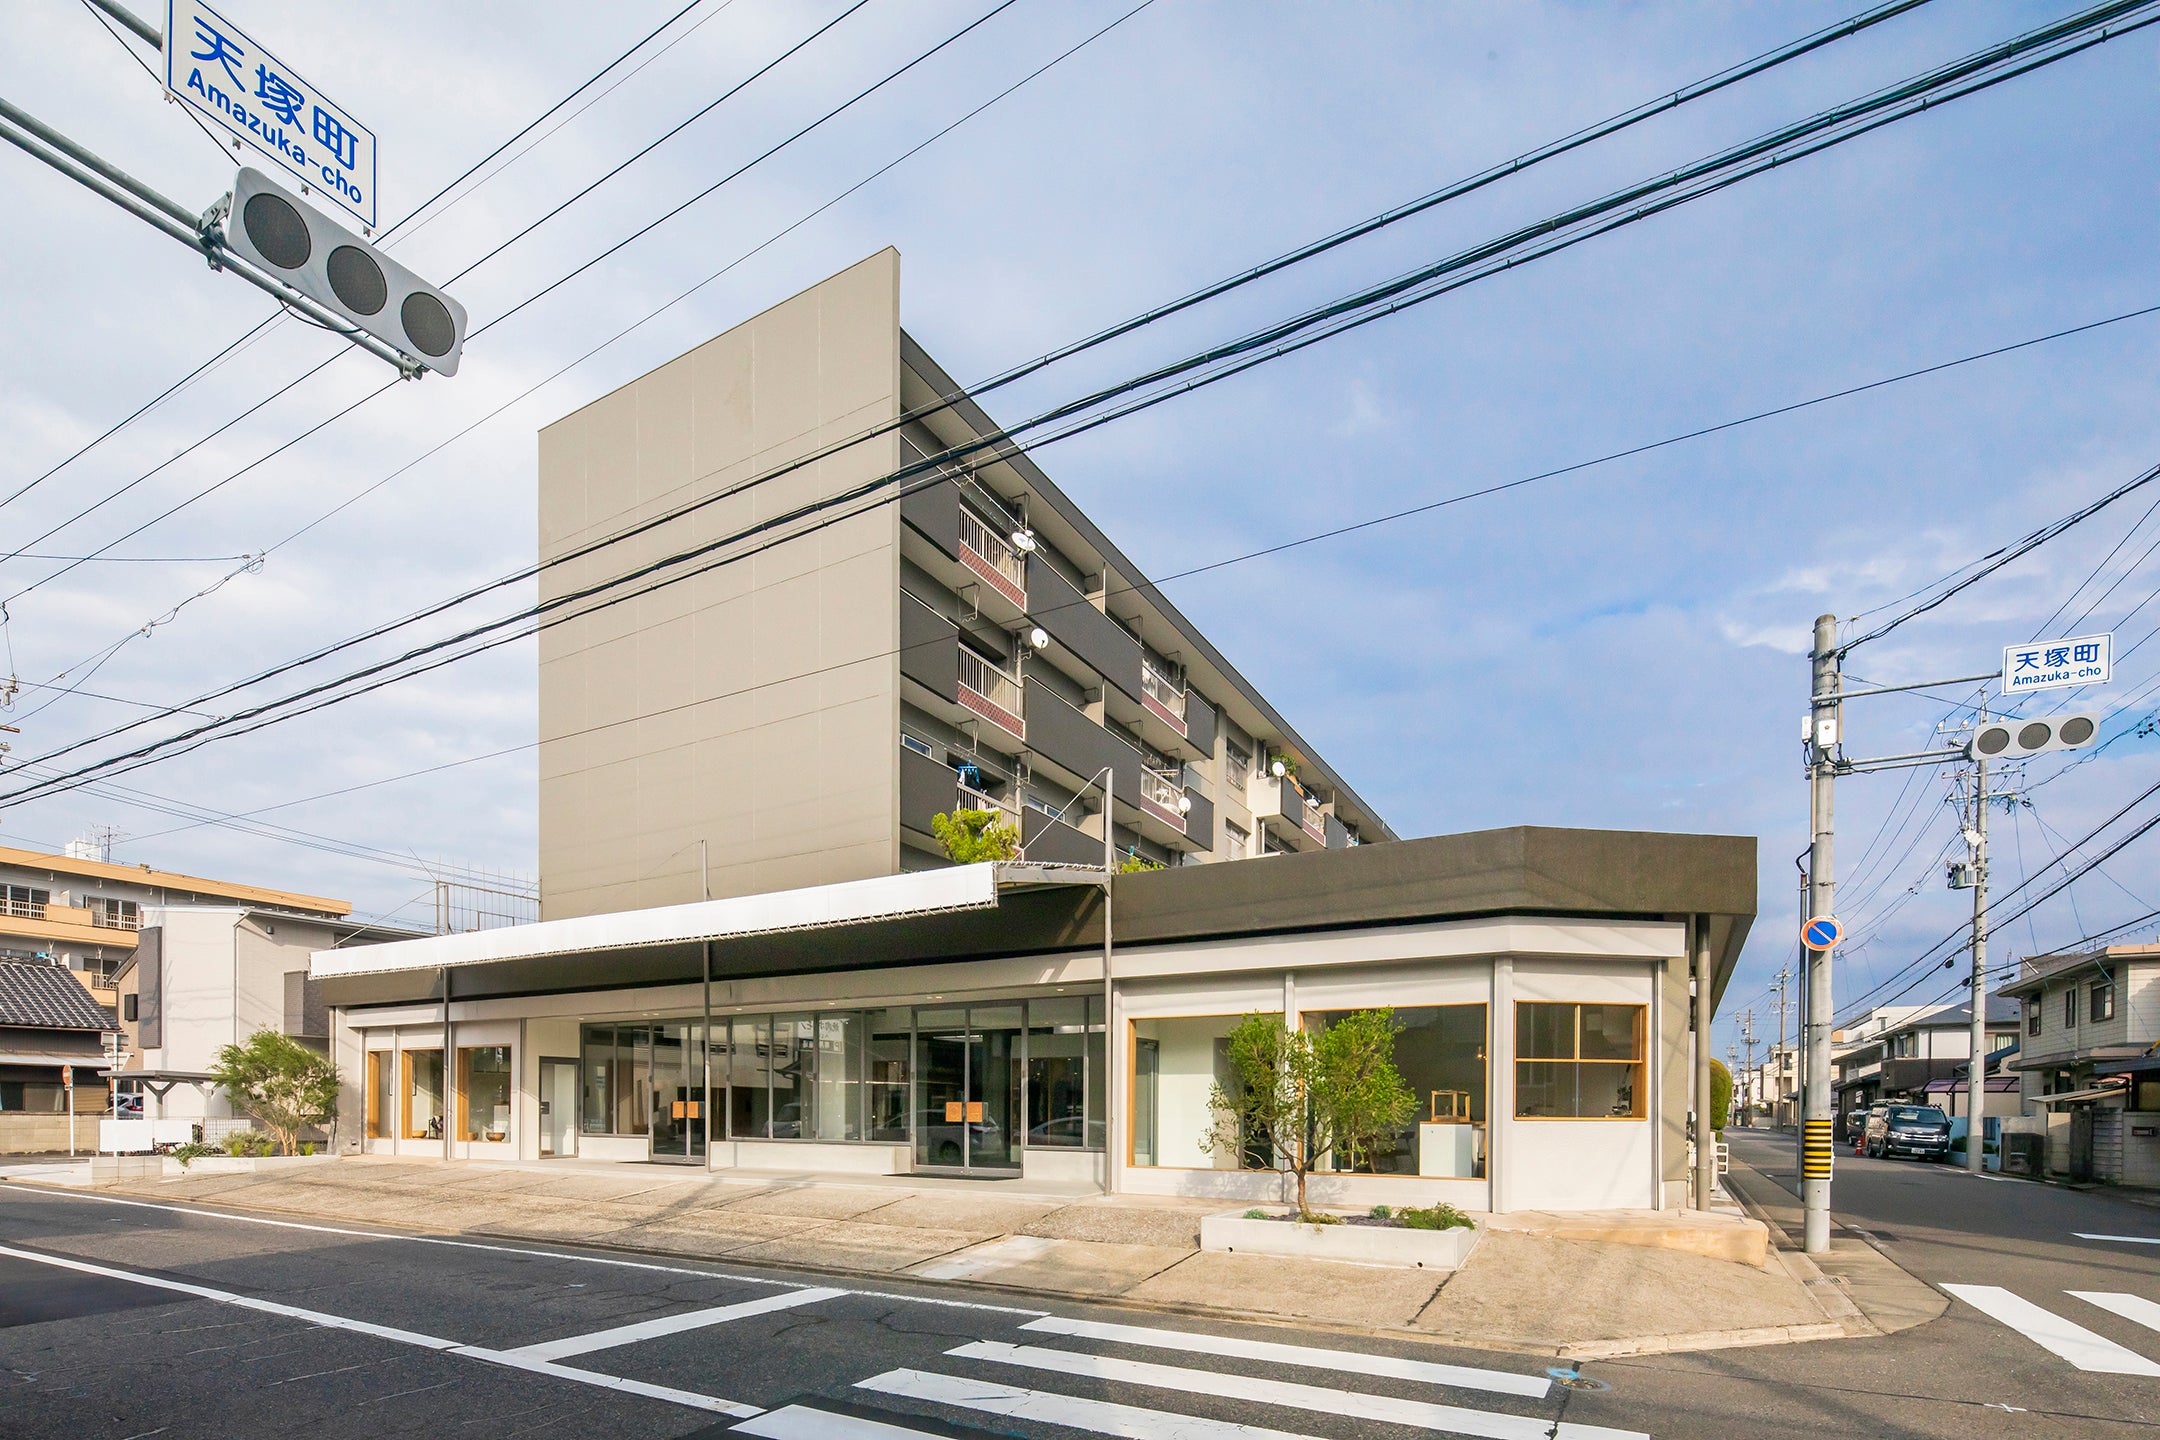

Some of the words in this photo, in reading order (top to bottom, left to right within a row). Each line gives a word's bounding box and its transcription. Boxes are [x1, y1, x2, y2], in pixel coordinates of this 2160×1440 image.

[190, 15, 360, 171] 天塚町
[187, 67, 363, 204] Amazuka-cho
[2012, 666, 2102, 686] Amazuka-cho
[2014, 643, 2101, 673] 天塚町
